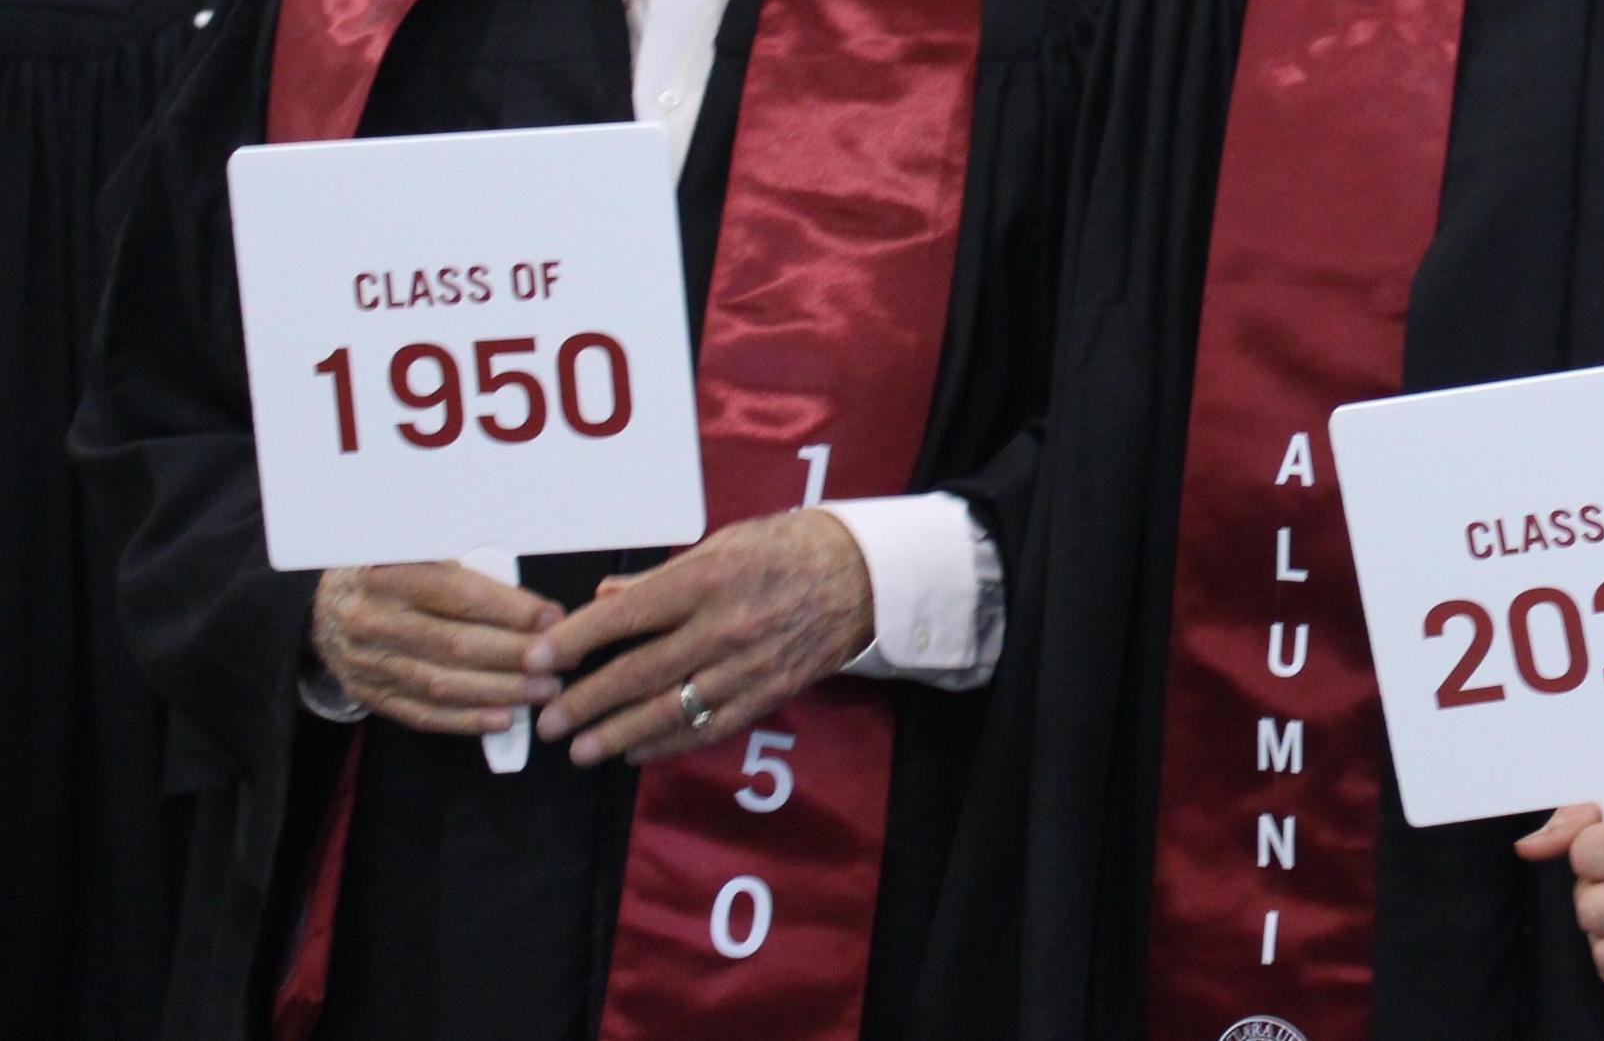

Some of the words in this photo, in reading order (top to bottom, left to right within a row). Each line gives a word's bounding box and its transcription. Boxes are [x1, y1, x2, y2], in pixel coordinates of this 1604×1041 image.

[354, 265, 492, 310] CLASS
[511, 261, 561, 301] OF
[314, 331, 633, 454] 1950
[1256, 430, 1316, 965] ALUMNI
